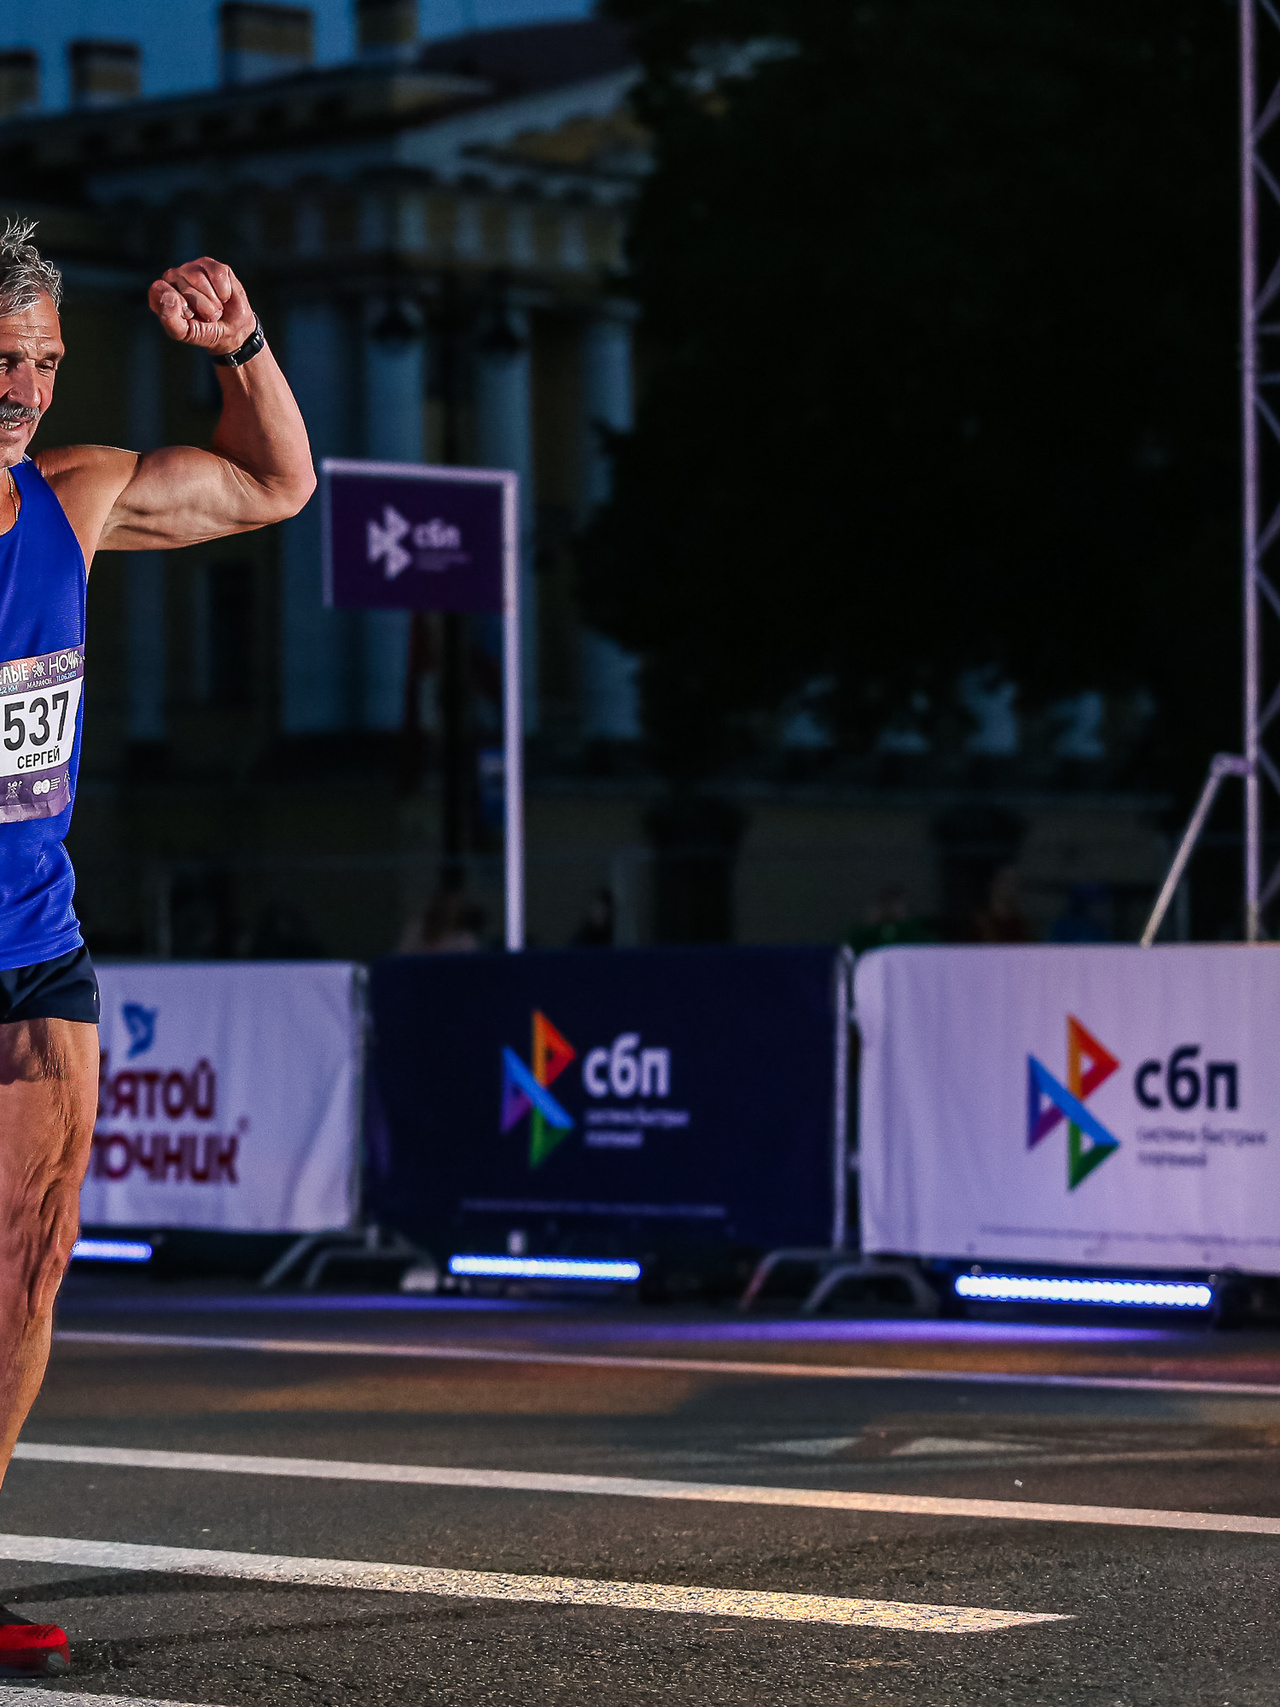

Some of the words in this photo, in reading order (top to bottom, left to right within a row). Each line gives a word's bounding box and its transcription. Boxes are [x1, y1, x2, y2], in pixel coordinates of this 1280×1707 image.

[3, 690, 70, 751] 537
[17, 745, 61, 770] СЕРГЕЙ
[99, 1051, 216, 1120] ятой
[582, 1032, 671, 1097] сбп
[1134, 1043, 1238, 1111] сбп
